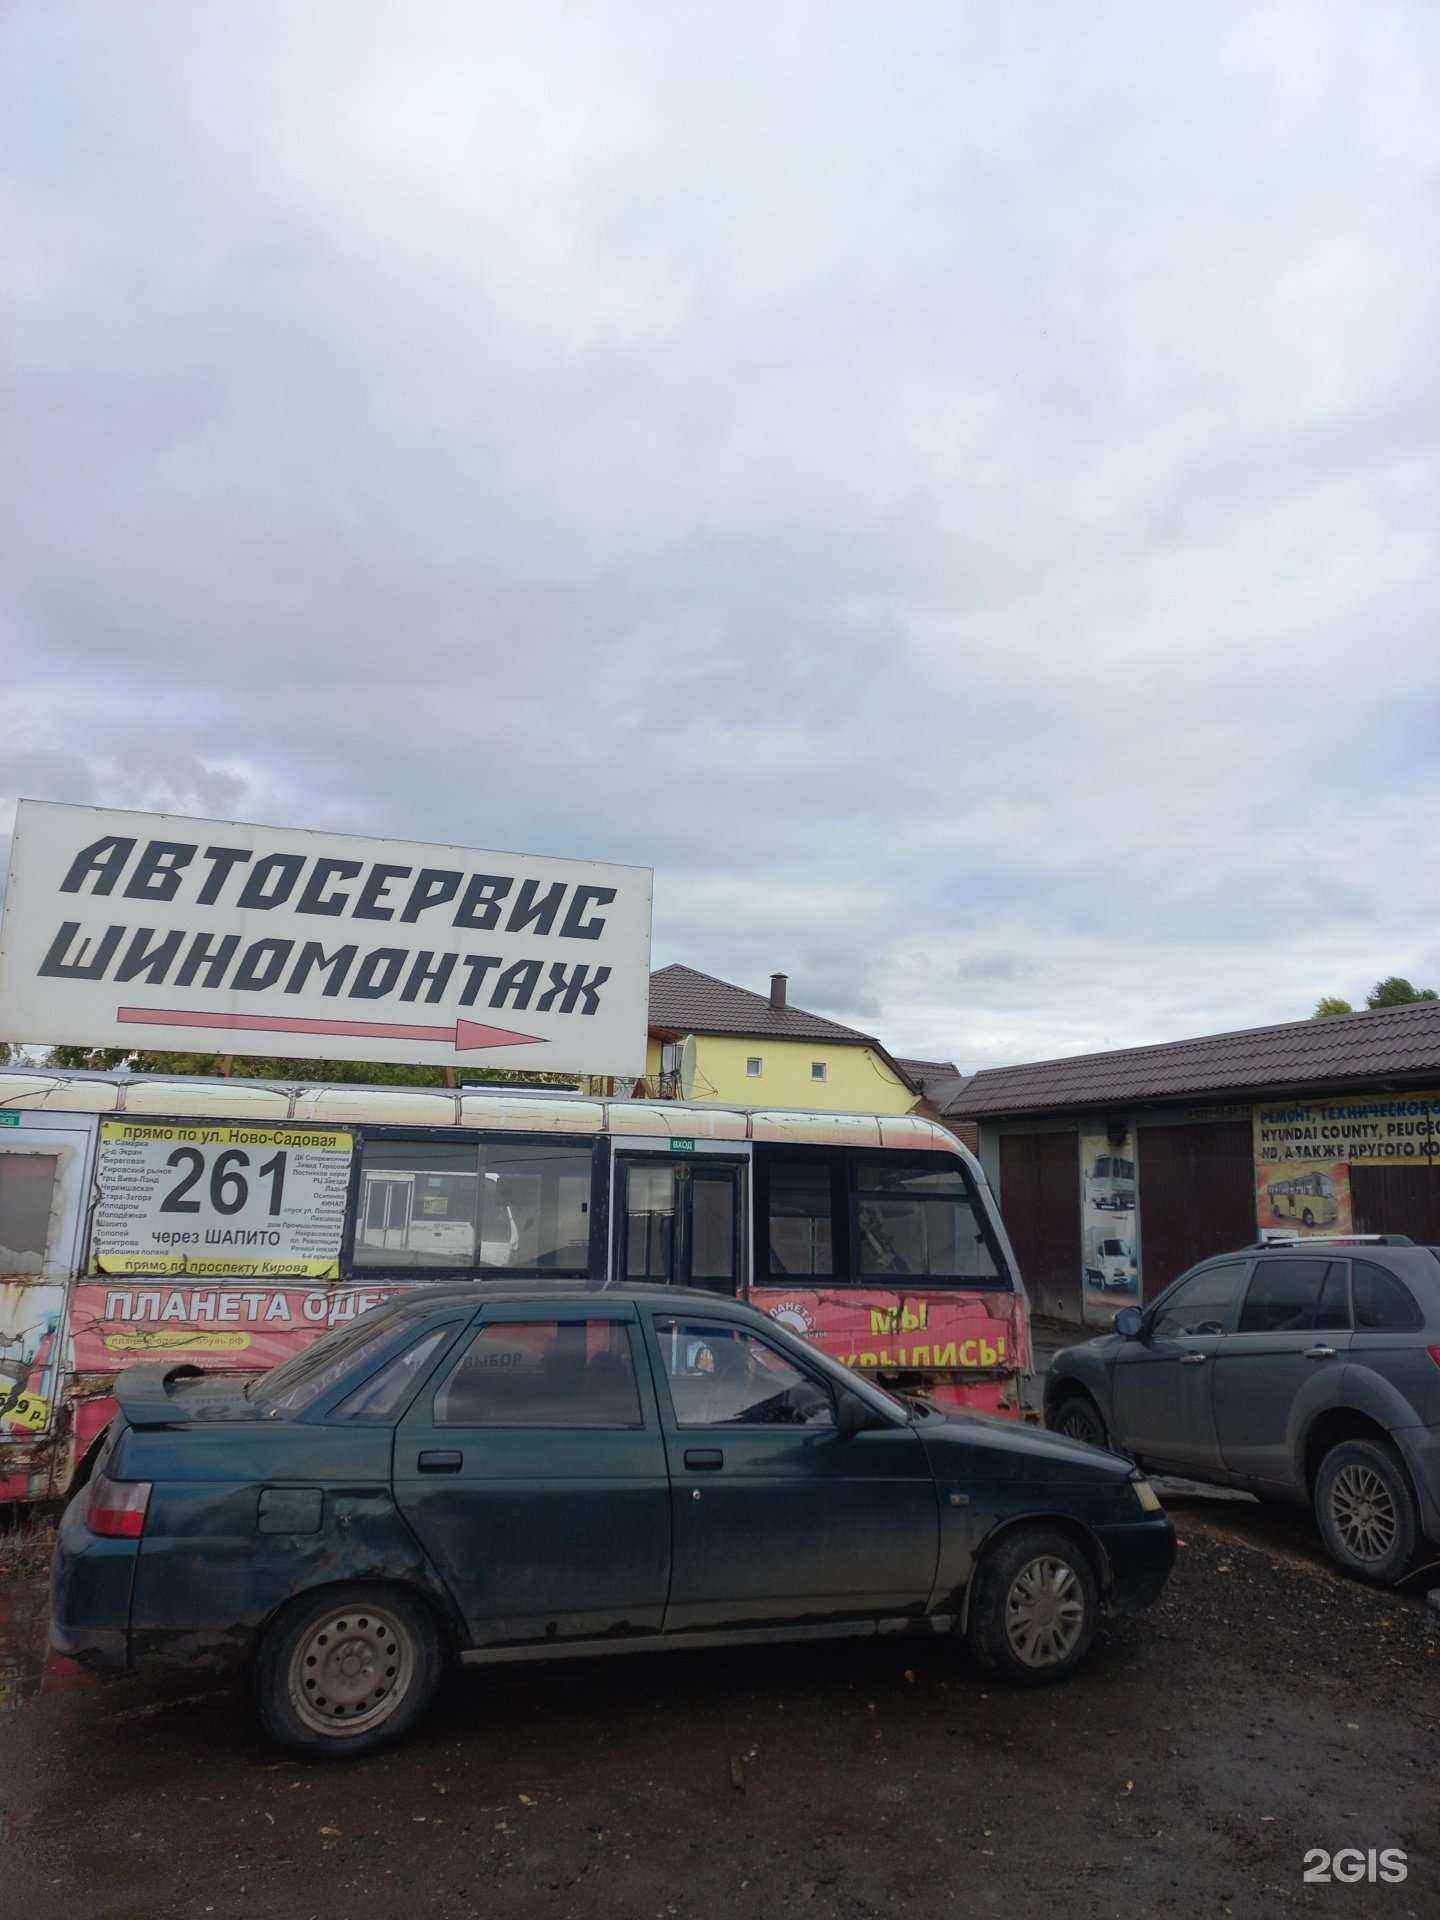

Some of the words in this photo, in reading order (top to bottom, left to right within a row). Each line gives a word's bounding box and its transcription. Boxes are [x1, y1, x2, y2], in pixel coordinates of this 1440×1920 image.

[59, 836, 617, 940] АВТОСЕРВИС
[37, 922, 611, 1015] ШИНОМОНТАЖ
[1260, 1106, 1317, 1124] РЕМОНТ,
[123, 1127, 174, 1141] прямо
[178, 1129, 197, 1141] по
[201, 1130, 224, 1145] ул.
[228, 1131, 337, 1148] Ново-Садовая
[1261, 1125, 1318, 1142] HYUNDAI
[1322, 1123, 1383, 1141] COUNTY,
[672, 1139, 693, 1151] ВХОД
[1295, 1143, 1345, 1159] ТАКЖЕ
[1348, 1141, 1414, 1160] ДРУГОГО
[102, 1165, 146, 1174] Кировский
[159, 1146, 288, 1217] 261
[152, 1231, 200, 1247] через
[204, 1229, 281, 1246] ШАПИТО
[125, 1261, 167, 1274] прямо
[170, 1262, 187, 1273] по
[191, 1262, 258, 1277] проспекту
[262, 1262, 308, 1275] Кирова
[105, 1291, 292, 1322] ПЛАНЕТА
[302, 1292, 386, 1327] ОДЕ
[870, 1298, 928, 1337] МЫ
